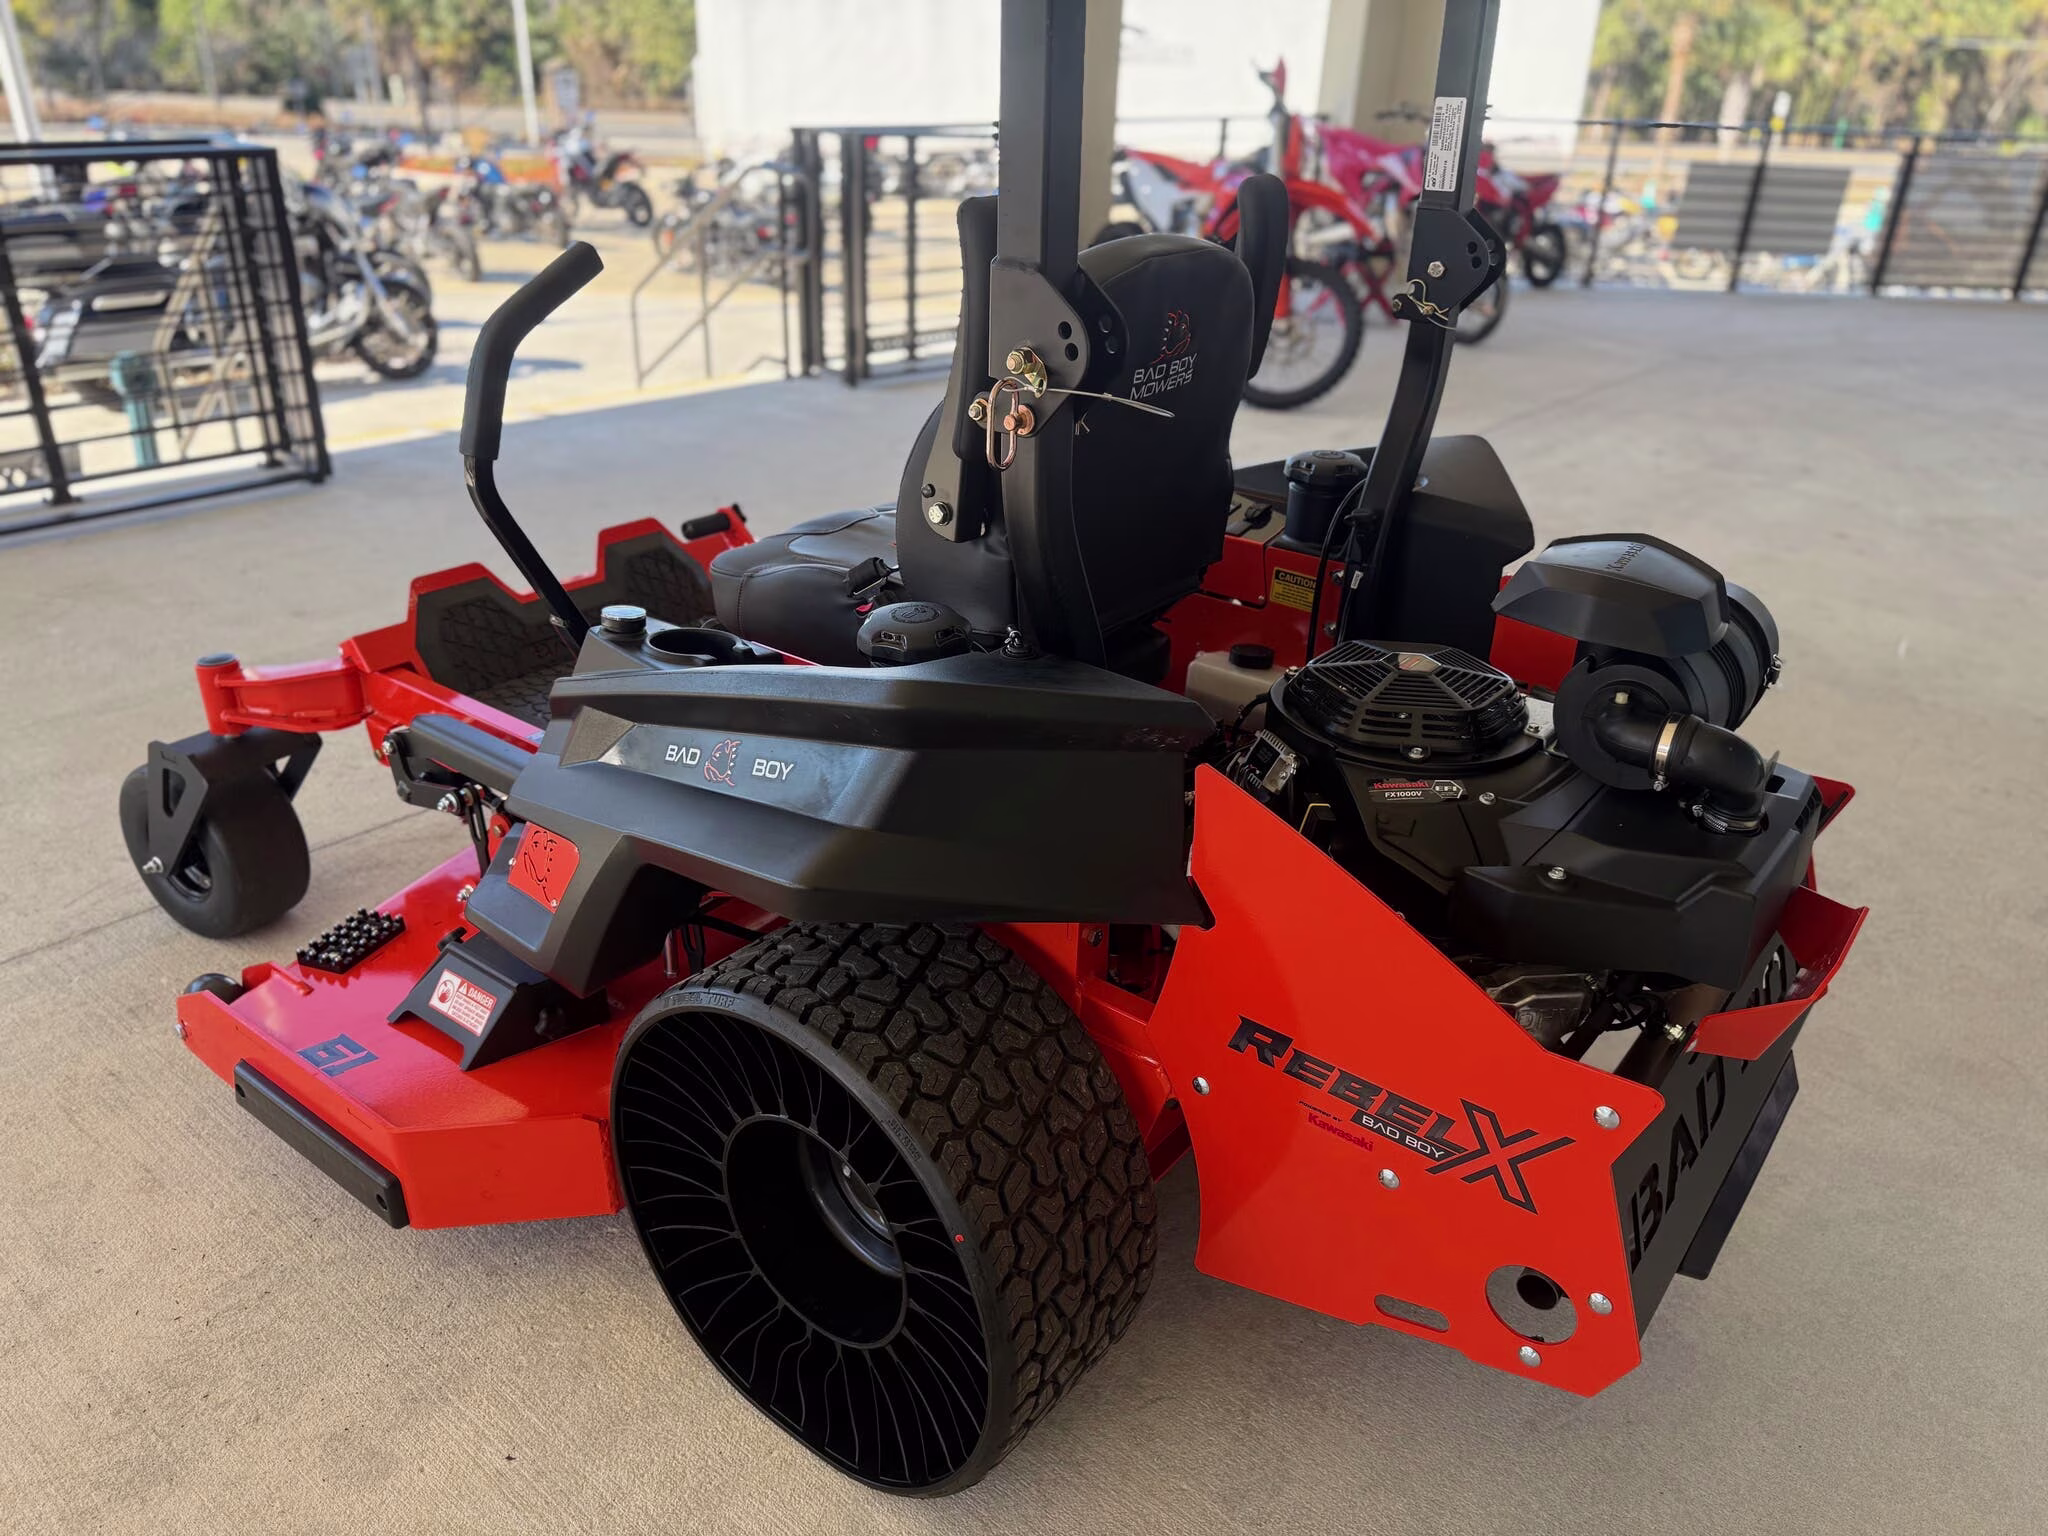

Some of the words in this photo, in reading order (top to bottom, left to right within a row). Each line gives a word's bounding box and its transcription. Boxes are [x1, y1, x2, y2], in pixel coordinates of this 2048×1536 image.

[1133, 364, 1167, 384] BAD
[1169, 353, 1197, 375] BOY
[1129, 369, 1194, 400] MOWERS
[1278, 571, 1316, 588] CAUTION
[665, 744, 701, 765] BAD
[752, 758, 795, 780] BOY
[1373, 781, 1429, 789] Kawasaki
[1385, 790, 1422, 798] FX1000V
[467, 987, 495, 1009] DANGER
[1227, 1014, 1469, 1154] REBEL
[1298, 1100, 1331, 1118] POWERED
[1307, 1112, 1374, 1152] Kawasaki
[1361, 1114, 1400, 1140] BAD
[1404, 1134, 1445, 1160] BOY
[1629, 1055, 1726, 1275] BAD
